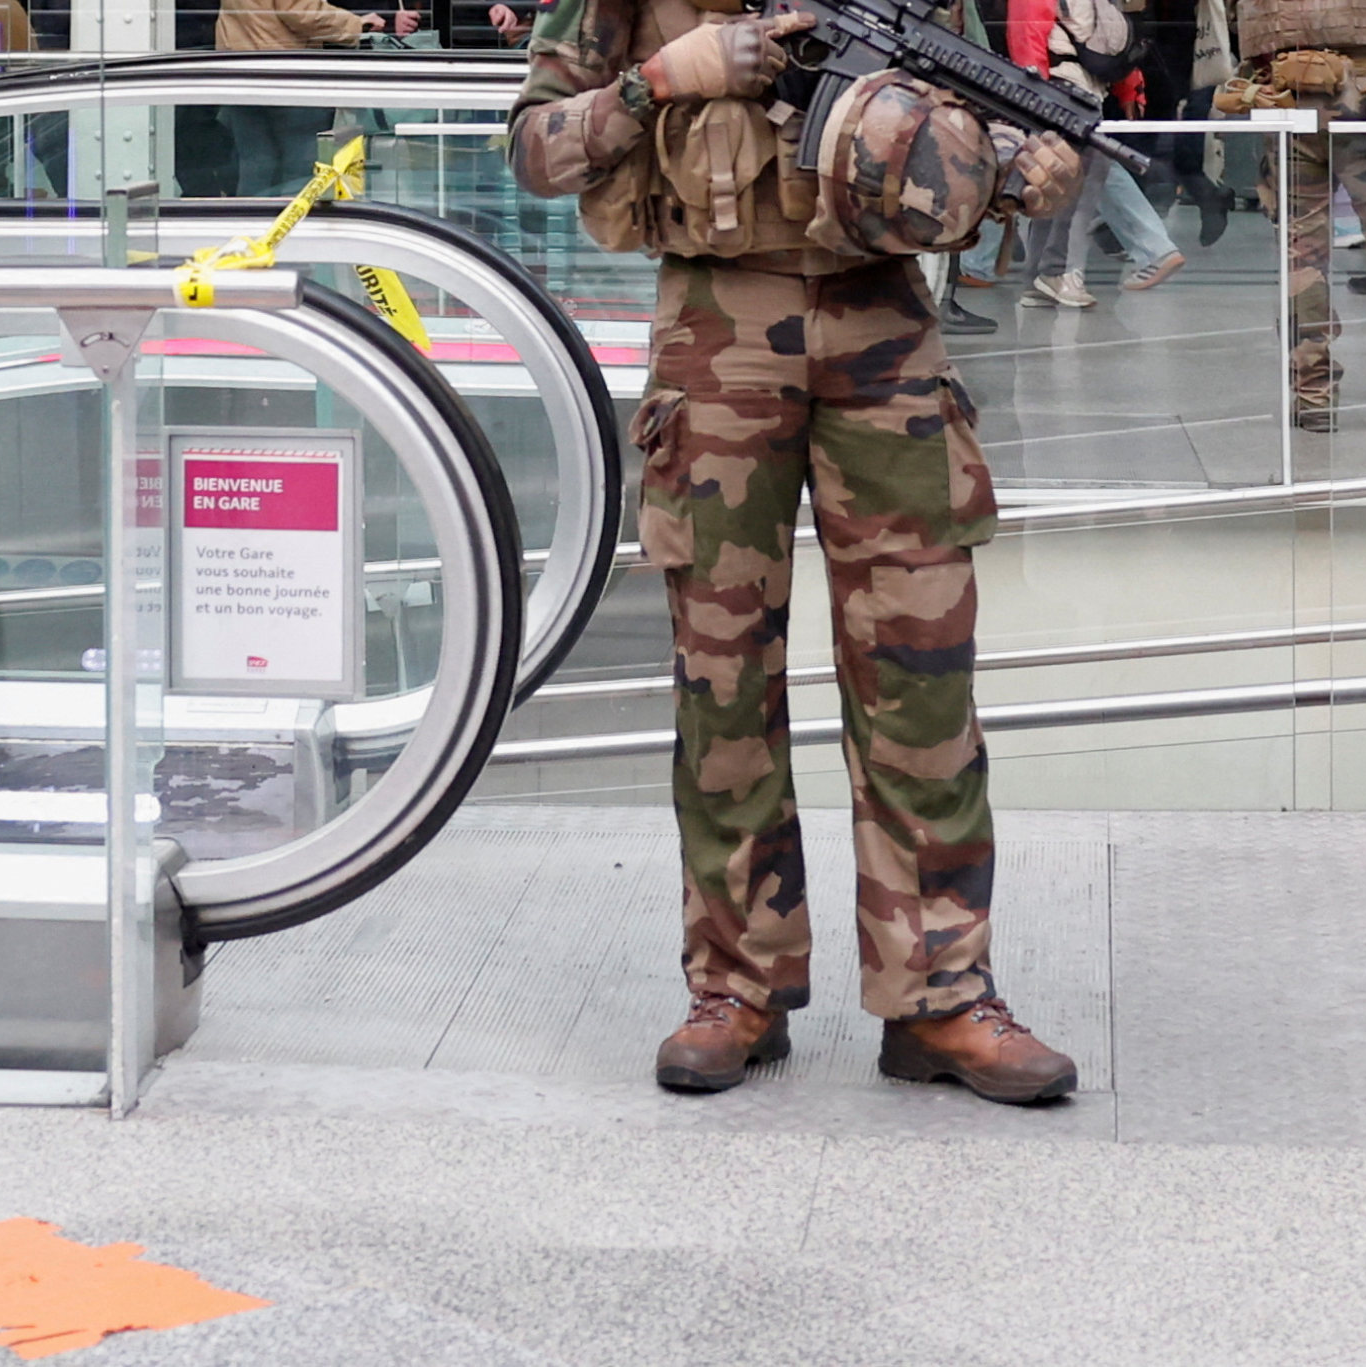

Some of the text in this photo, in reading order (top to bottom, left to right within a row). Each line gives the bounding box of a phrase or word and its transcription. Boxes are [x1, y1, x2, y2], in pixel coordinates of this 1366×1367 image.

[193, 477, 283, 493] BIENVENUE
[193, 496, 260, 510] EN GARE
[196, 546, 274, 560] Votre Gare
[195, 566, 295, 579] vous souhaite
[196, 584, 330, 600] une bonne journée
[195, 602, 322, 619] et un bon voyage.
